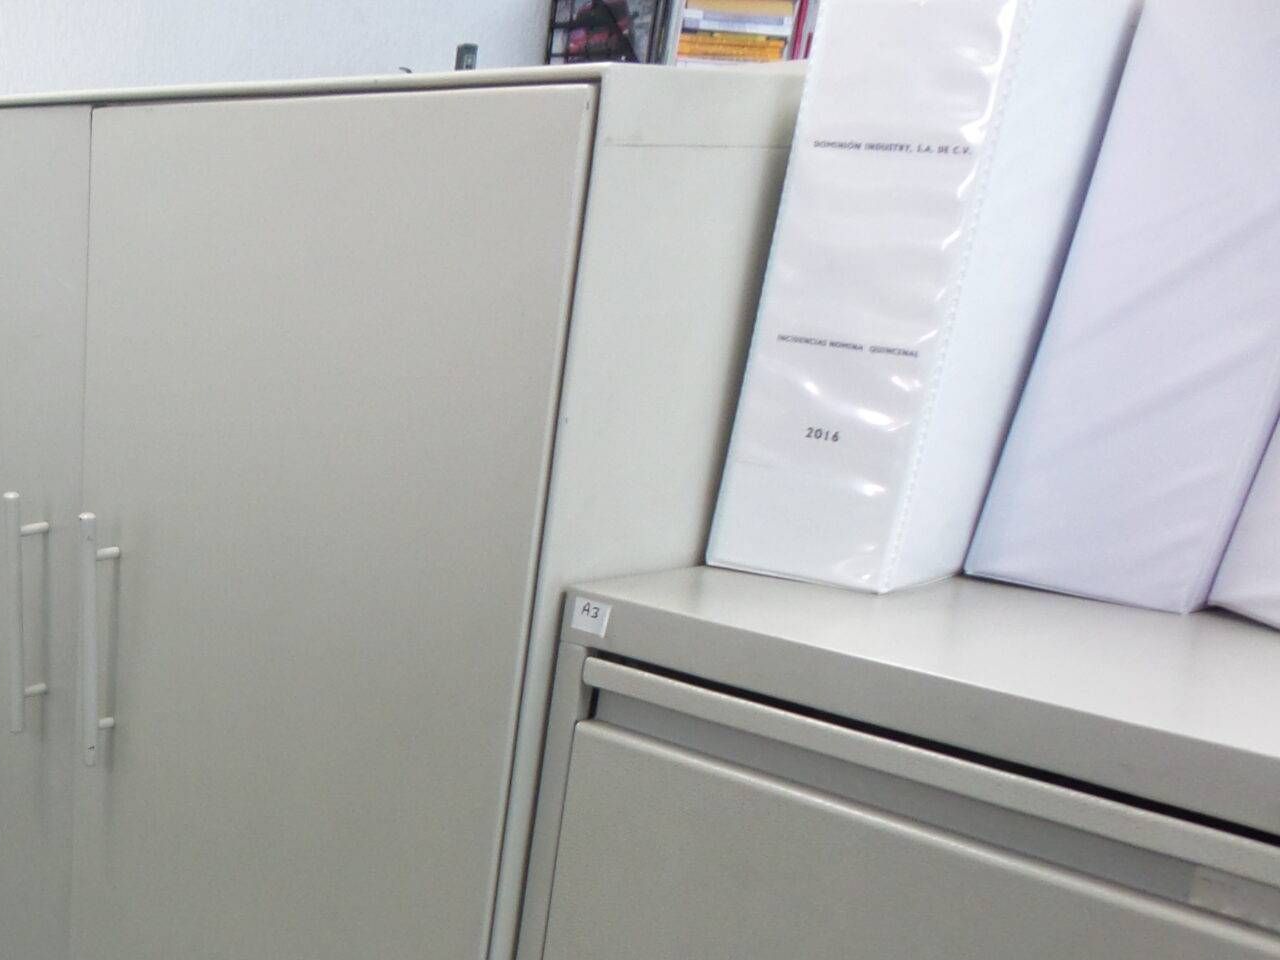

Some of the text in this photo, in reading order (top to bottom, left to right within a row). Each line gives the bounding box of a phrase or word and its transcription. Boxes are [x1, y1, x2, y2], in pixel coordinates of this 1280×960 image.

[936, 145, 949, 154] DE
[952, 145, 973, 155] C.V.
[805, 426, 840, 443] 2016
[581, 601, 600, 619] A3
